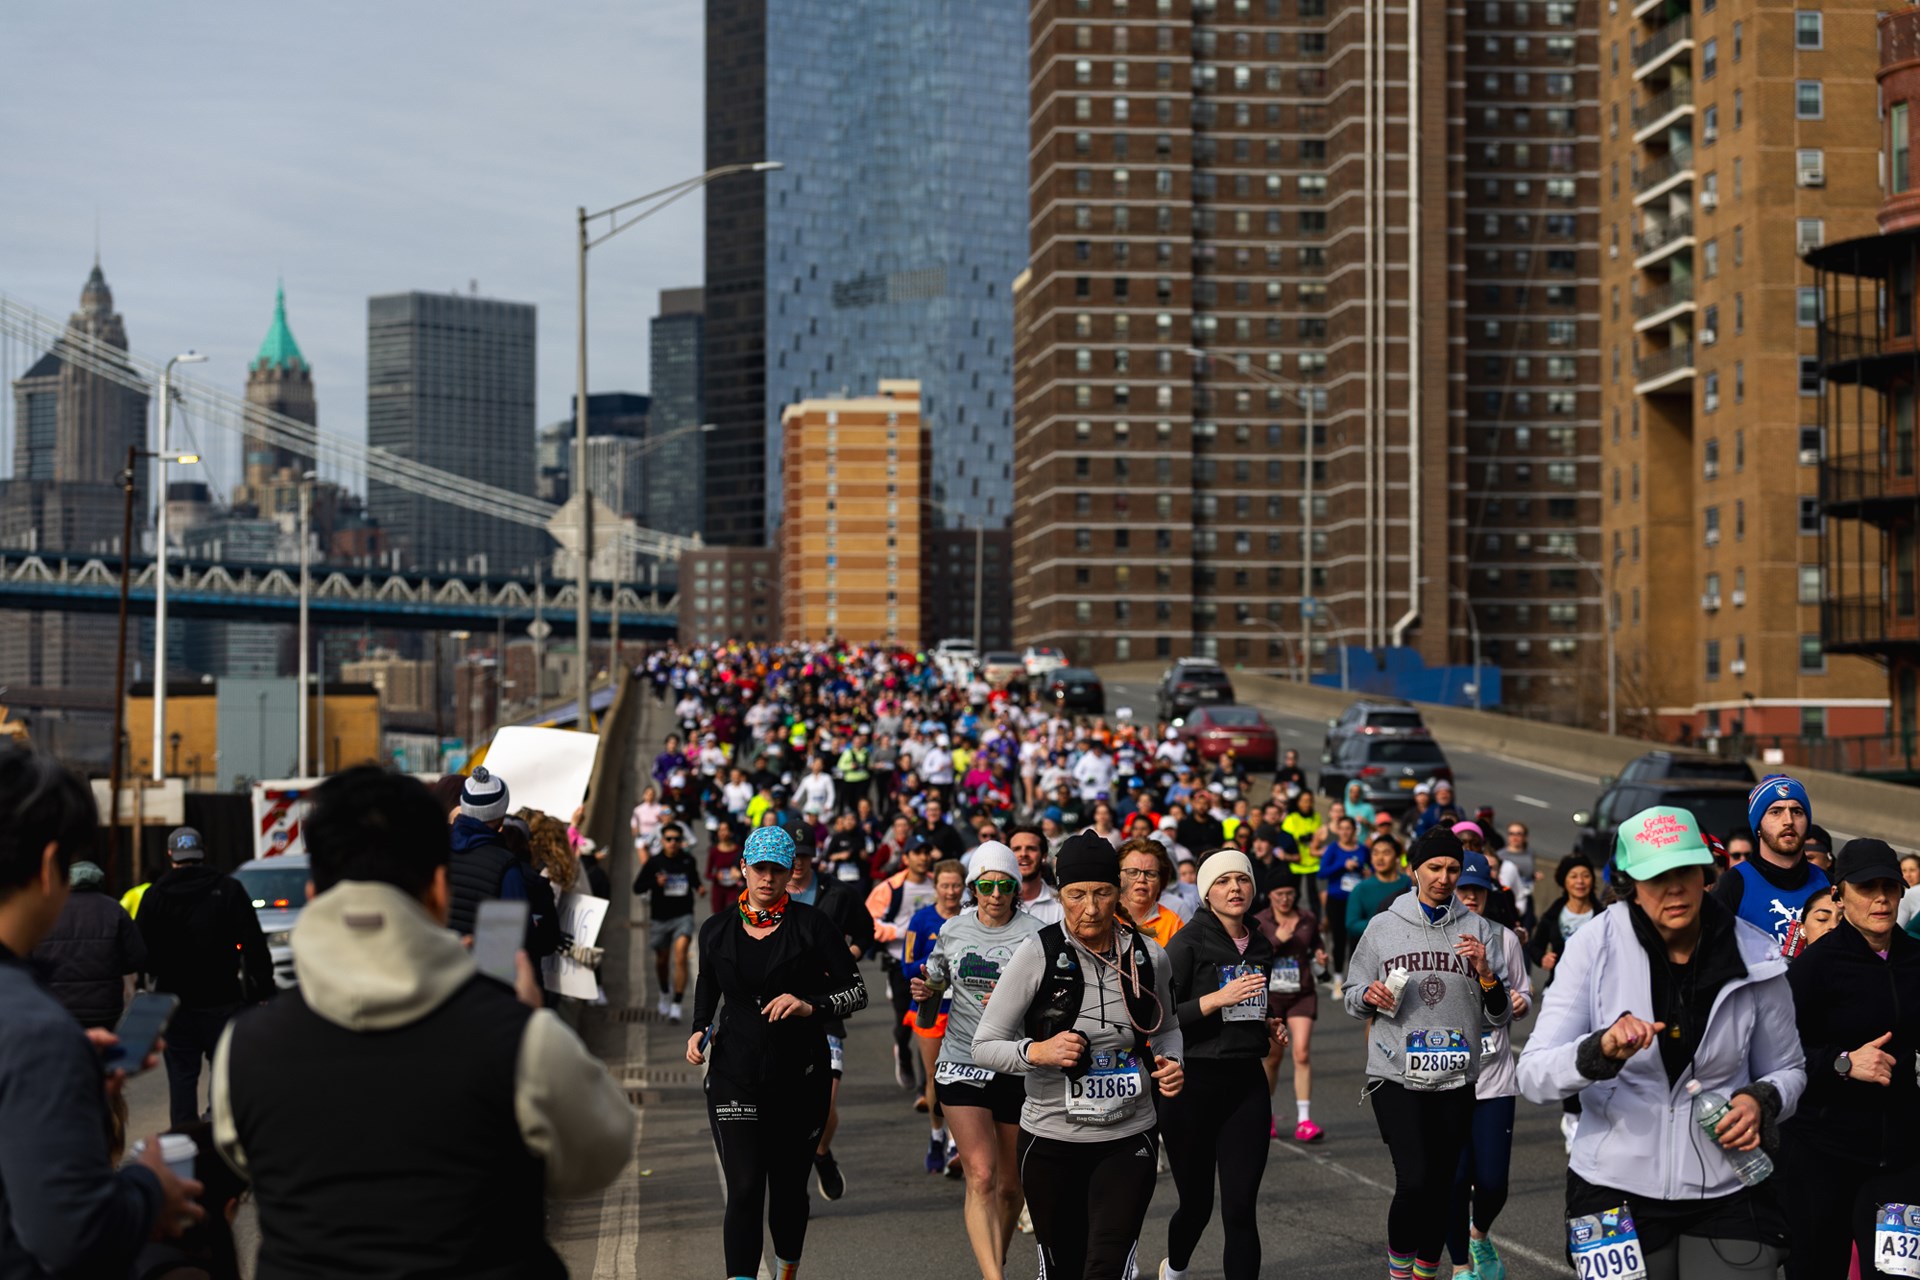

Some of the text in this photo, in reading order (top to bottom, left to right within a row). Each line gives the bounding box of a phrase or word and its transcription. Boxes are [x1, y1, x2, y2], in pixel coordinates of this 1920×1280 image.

[1643, 814, 1677, 830] Going
[1634, 824, 1688, 844] Nowhere
[1650, 834, 1680, 848] Fast
[939, 1061, 989, 1080] B24601
[1411, 1054, 1466, 1071] D28053
[1071, 1076, 1136, 1098] D31865
[1882, 1236, 1920, 1260] A32
